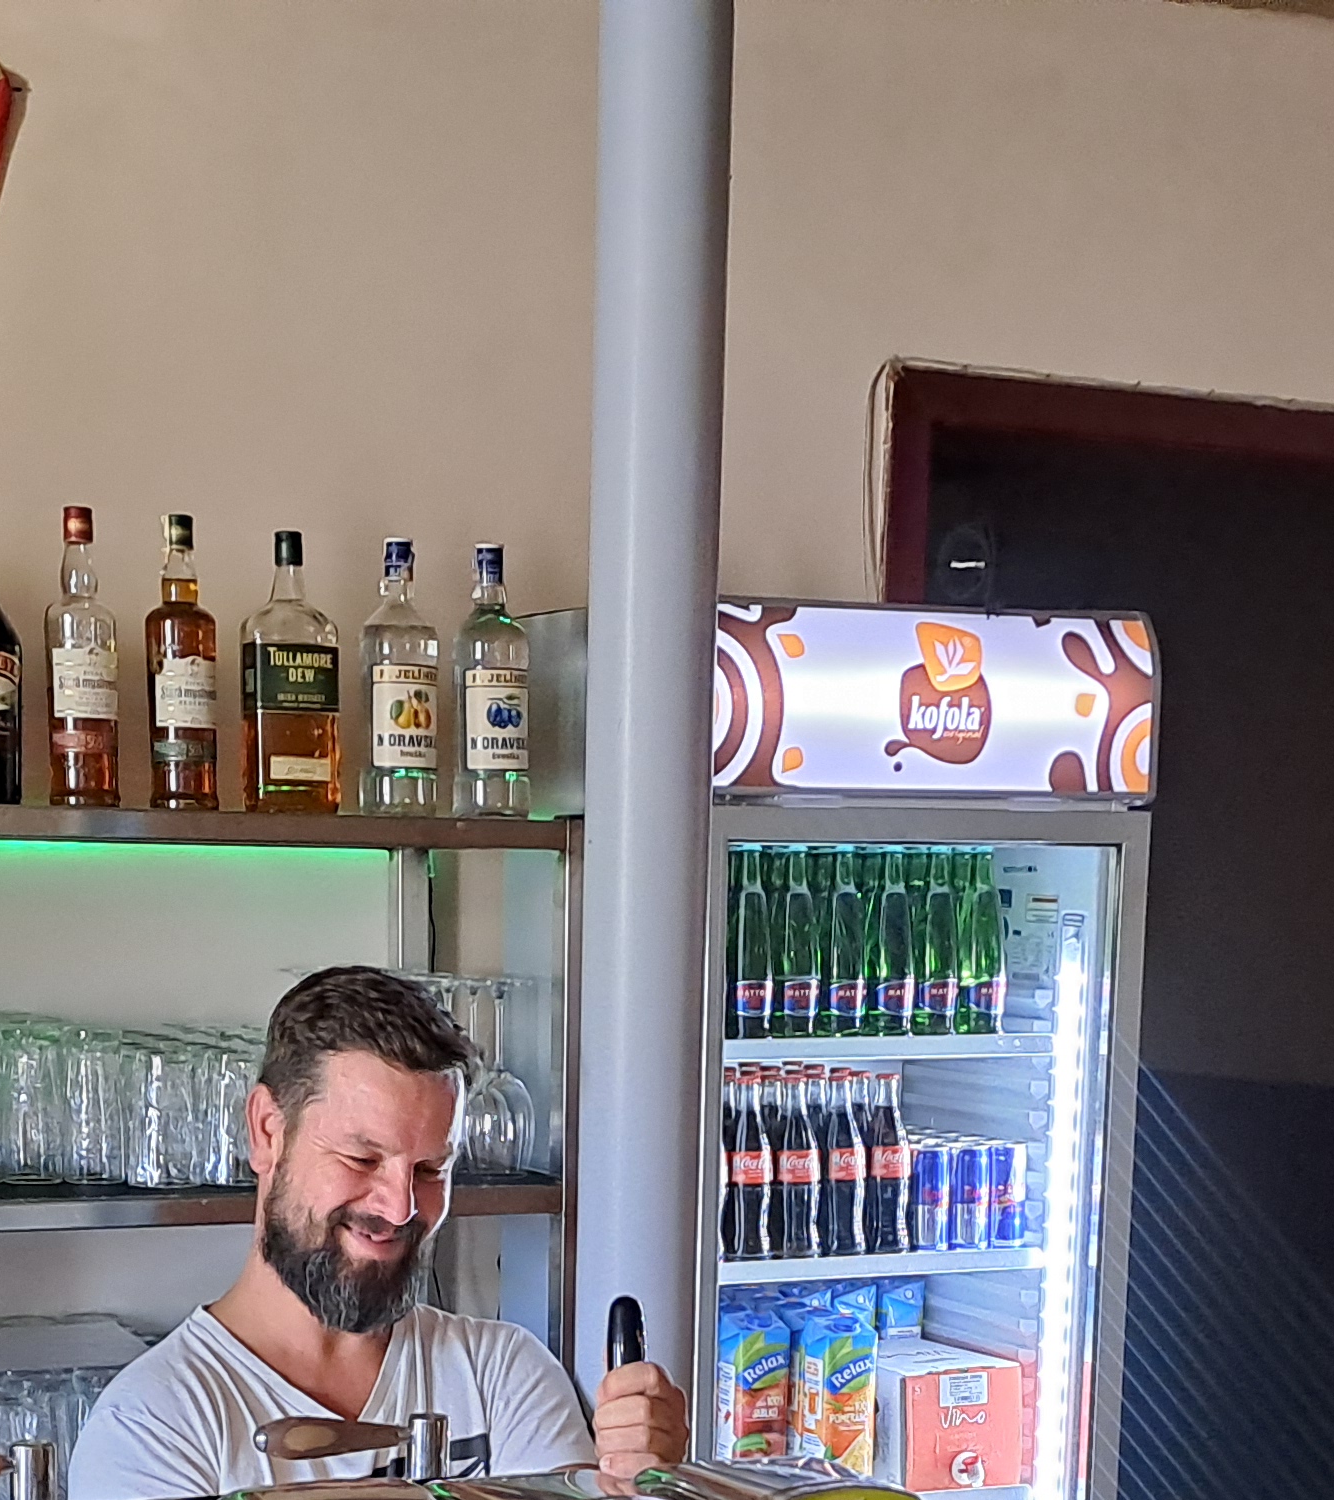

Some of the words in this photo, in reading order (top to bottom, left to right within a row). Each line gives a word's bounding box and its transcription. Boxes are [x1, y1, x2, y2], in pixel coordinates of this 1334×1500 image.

[267, 646, 334, 669] TULLAMORE
[288, 667, 316, 683] DEW
[907, 694, 981, 740] kofola
[942, 724, 986, 746] original
[743, 1352, 786, 1384] Relax
[830, 1355, 874, 1389] Relax
